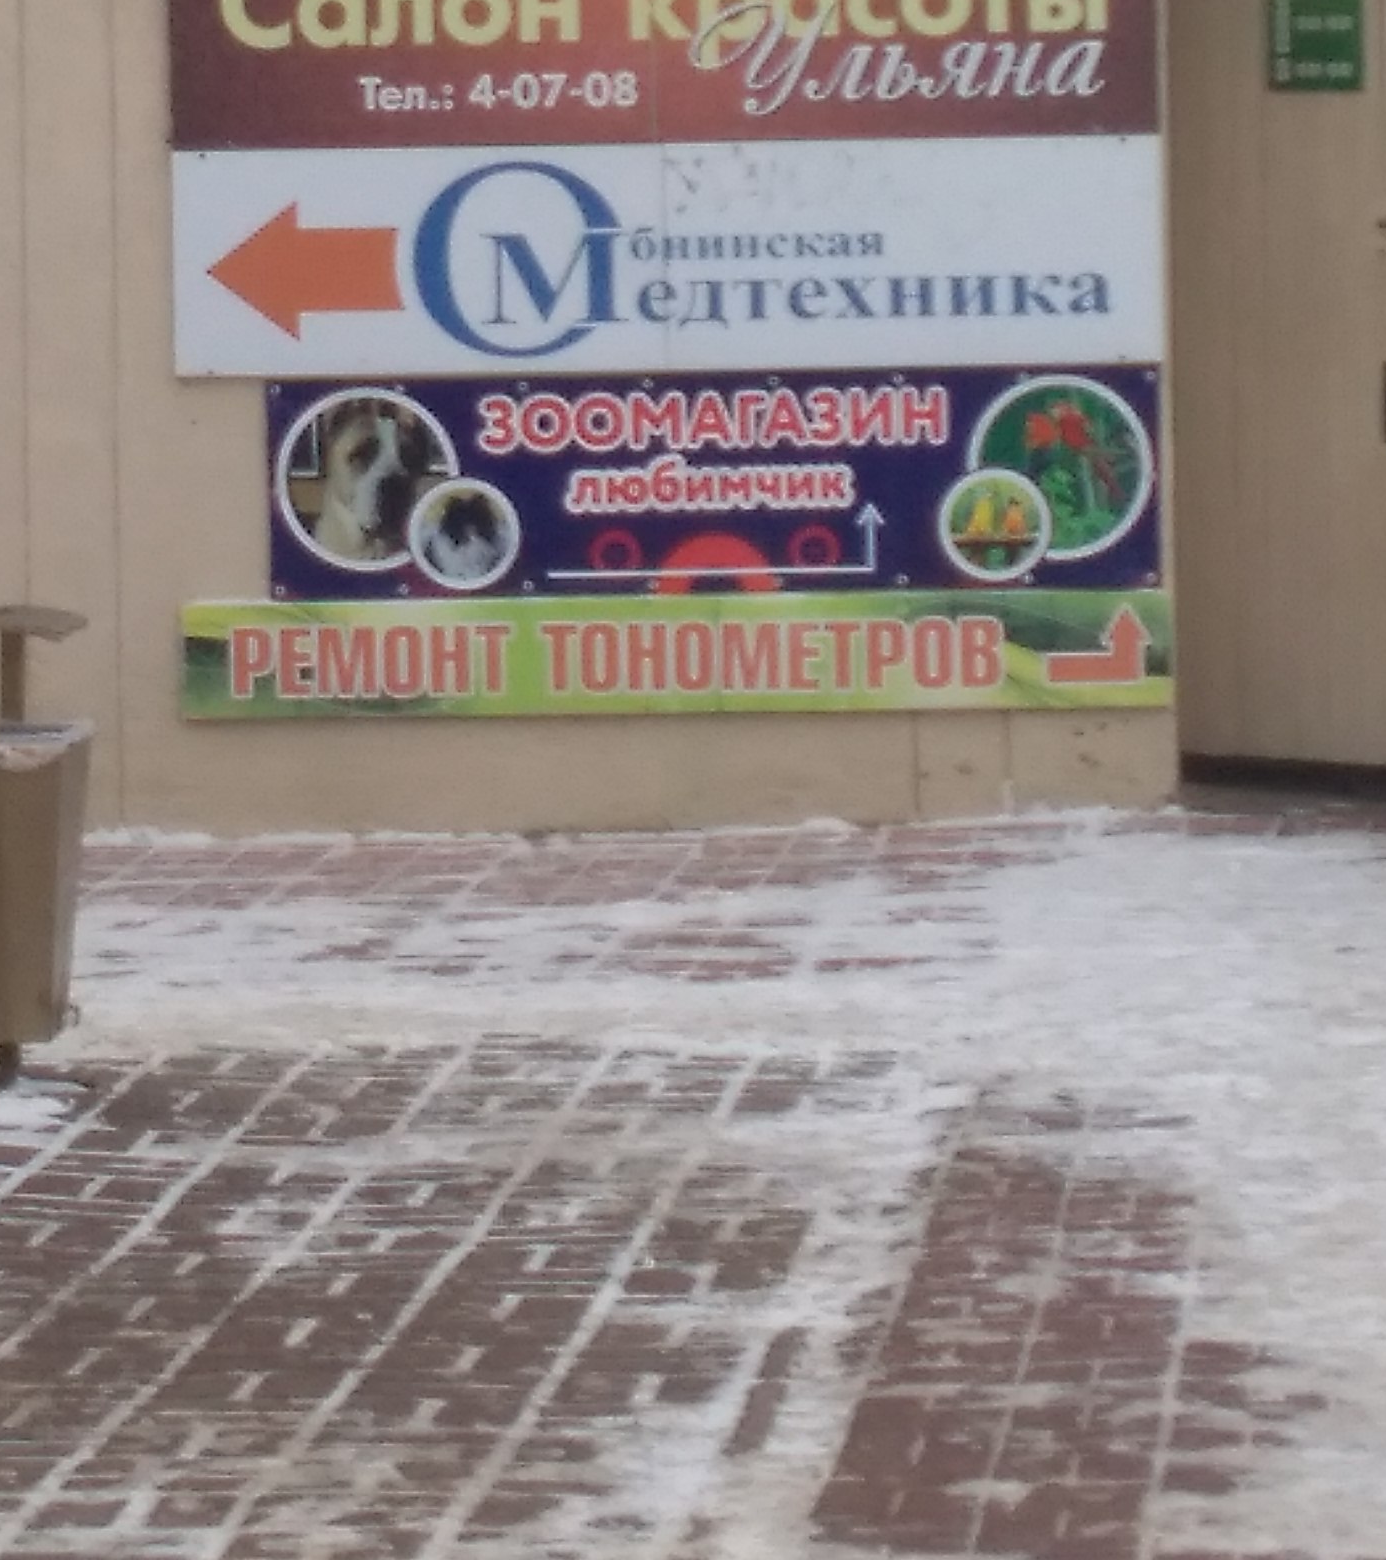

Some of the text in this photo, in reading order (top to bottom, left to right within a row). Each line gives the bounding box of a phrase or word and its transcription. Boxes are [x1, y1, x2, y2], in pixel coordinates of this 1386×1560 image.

[687, 0, 1107, 115] Ульяна
[358, 71, 639, 110] Тел.: 4-07-08
[479, 386, 947, 451] ЗООМАГАЗИН
[566, 453, 855, 512] любимчик
[229, 614, 1006, 699] РЕМОНТ ТОНОМЕТРОВ
